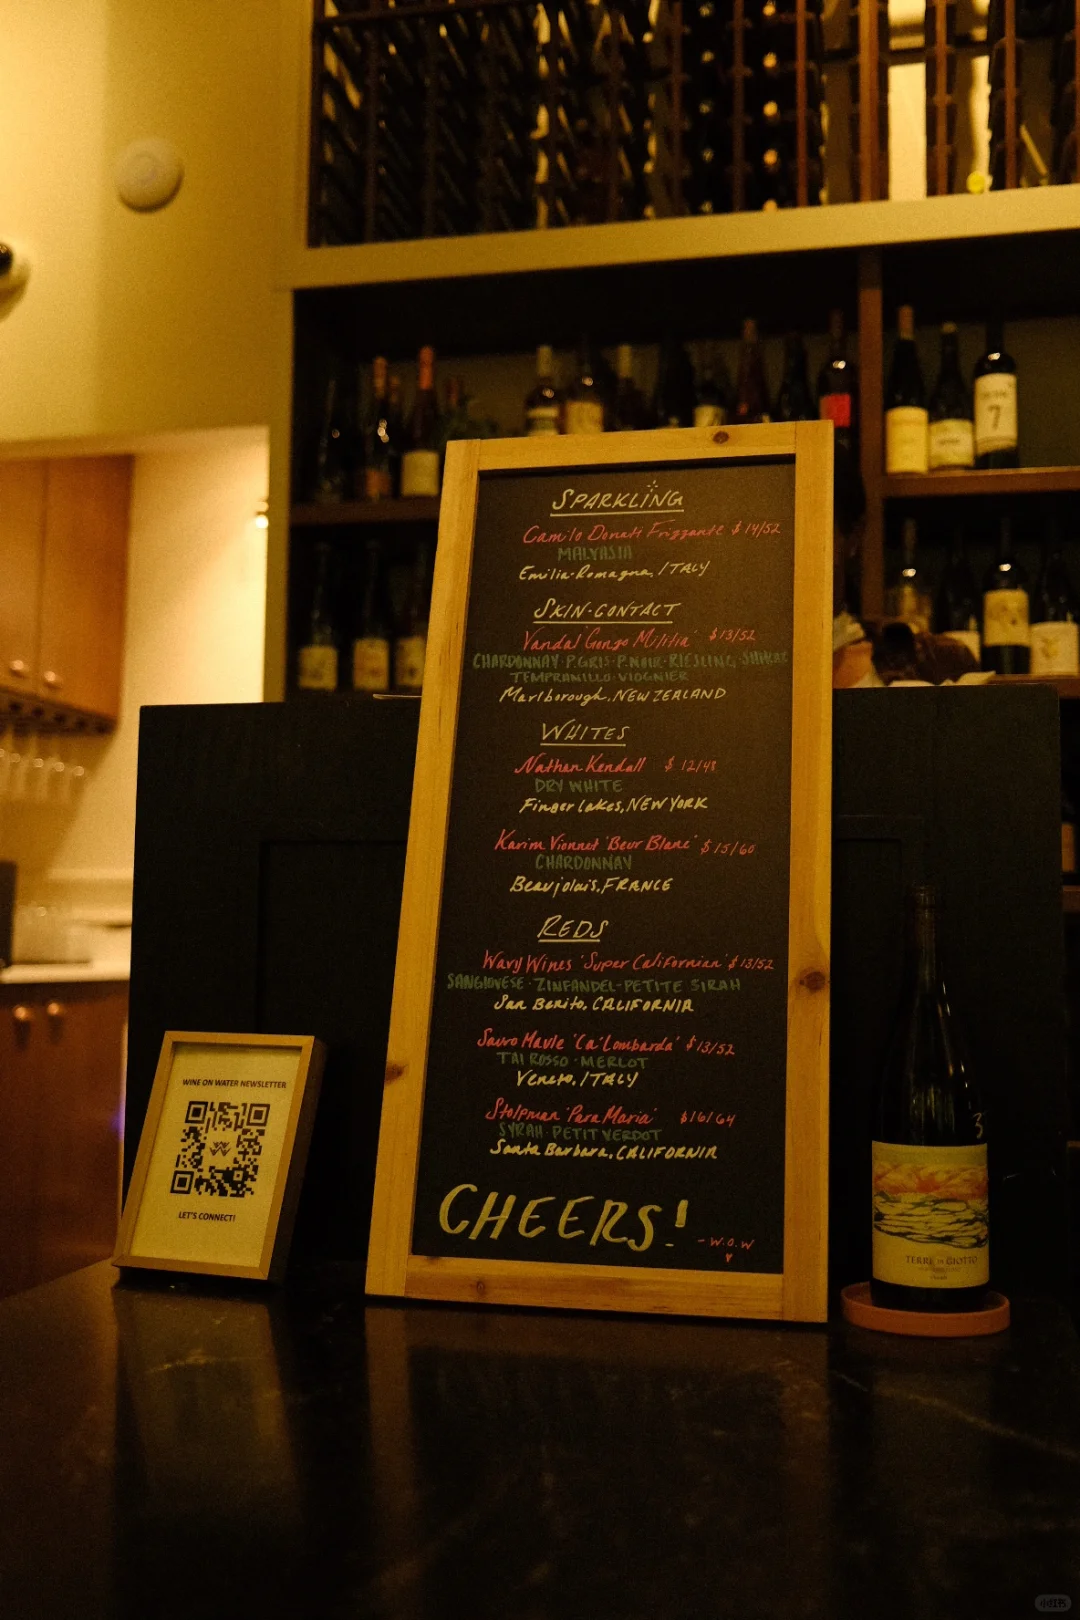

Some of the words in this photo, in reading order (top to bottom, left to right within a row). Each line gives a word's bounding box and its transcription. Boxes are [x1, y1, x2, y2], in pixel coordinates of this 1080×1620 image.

[552, 488, 683, 510] SPARKLING
[523, 524, 582, 544] Camilo
[587, 523, 642, 542] Donati
[647, 519, 723, 540] Frizzante
[523, 626, 580, 651] Vandal
[611, 688, 651, 702] NEW
[653, 687, 726, 701] ZEALAND
[541, 719, 630, 740] WHITES
[514, 752, 581, 774] Nathan
[587, 752, 647, 774] Kendall
[535, 779, 563, 793] DRY
[569, 779, 623, 793] WHITE
[519, 797, 574, 814] Finger
[626, 796, 668, 812] NEW
[670, 795, 708, 811] YORK
[602, 876, 674, 893] FRANCE
[537, 914, 609, 939] REDS
[483, 950, 523, 975] Wavy
[526, 952, 573, 974] Wines
[494, 994, 526, 1011] San
[593, 996, 694, 1012] CALIFORNIA
[496, 1051, 524, 1065] TAI
[530, 1053, 569, 1068] ROSSO
[581, 1055, 648, 1069] MERLOT
[182, 1078, 201, 1086] WINE
[214, 1079, 239, 1087] WATER
[240, 1080, 287, 1089] NEWSLETTER
[580, 1071, 639, 1088] ITALY
[498, 1122, 543, 1139] SYRAH
[553, 1125, 597, 1141] PETIT
[602, 1127, 662, 1142] VERDOT
[489, 1138, 540, 1156] Santa
[616, 1142, 718, 1160] CALIFORNIA
[178, 1211, 197, 1220] LET'S
[198, 1212, 236, 1222] CONNECT!
[438, 1183, 689, 1252] CHEERS!
[906, 1255, 933, 1265] TERRE
[946, 1255, 978, 1265] GIOTTO
